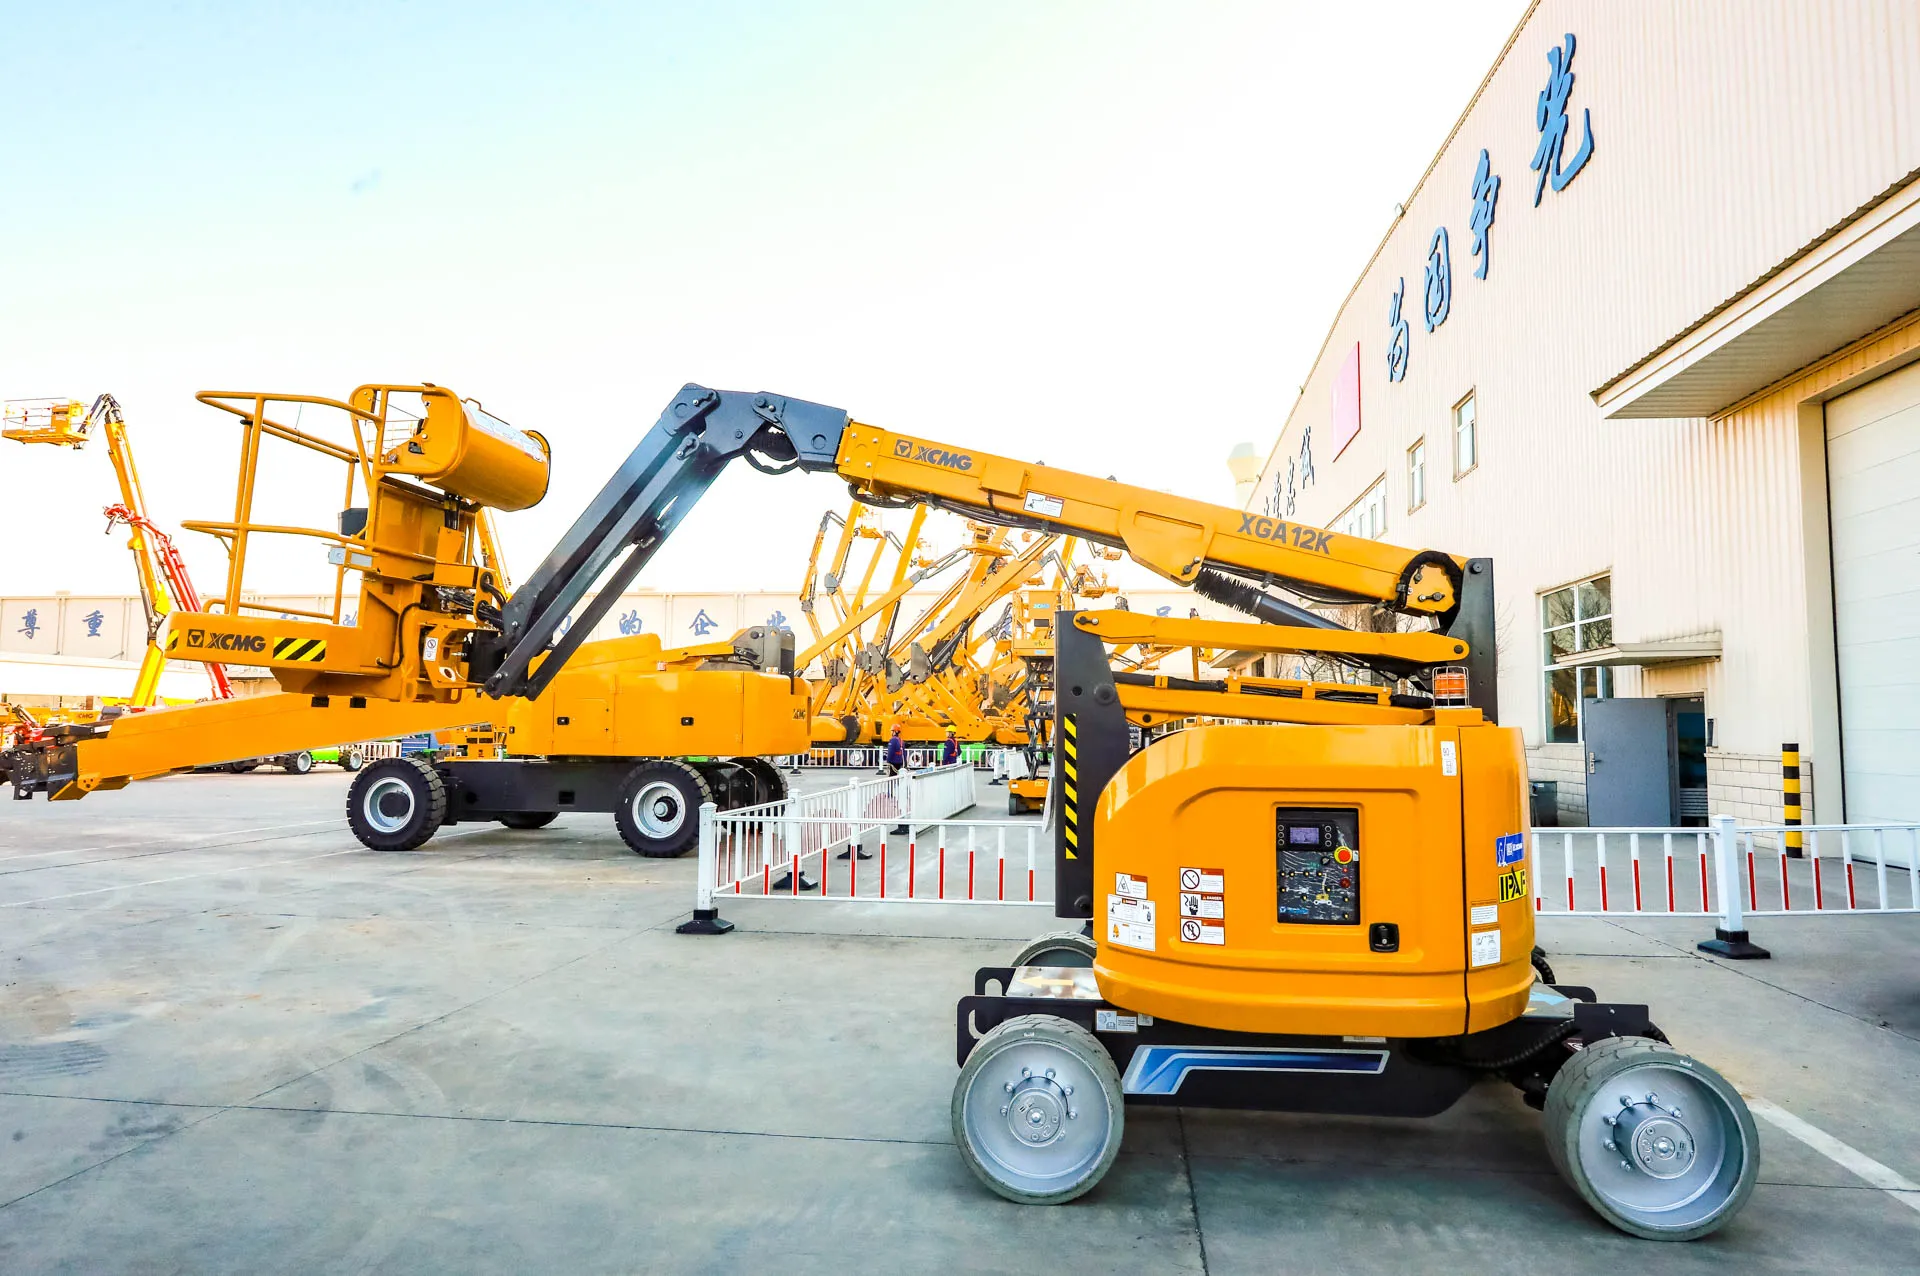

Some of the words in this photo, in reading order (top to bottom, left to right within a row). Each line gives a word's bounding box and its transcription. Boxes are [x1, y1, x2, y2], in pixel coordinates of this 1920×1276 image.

[912, 445, 973, 471] XCMG
[205, 632, 267, 653] XCMG
[1500, 866, 1526, 901] IPAF
